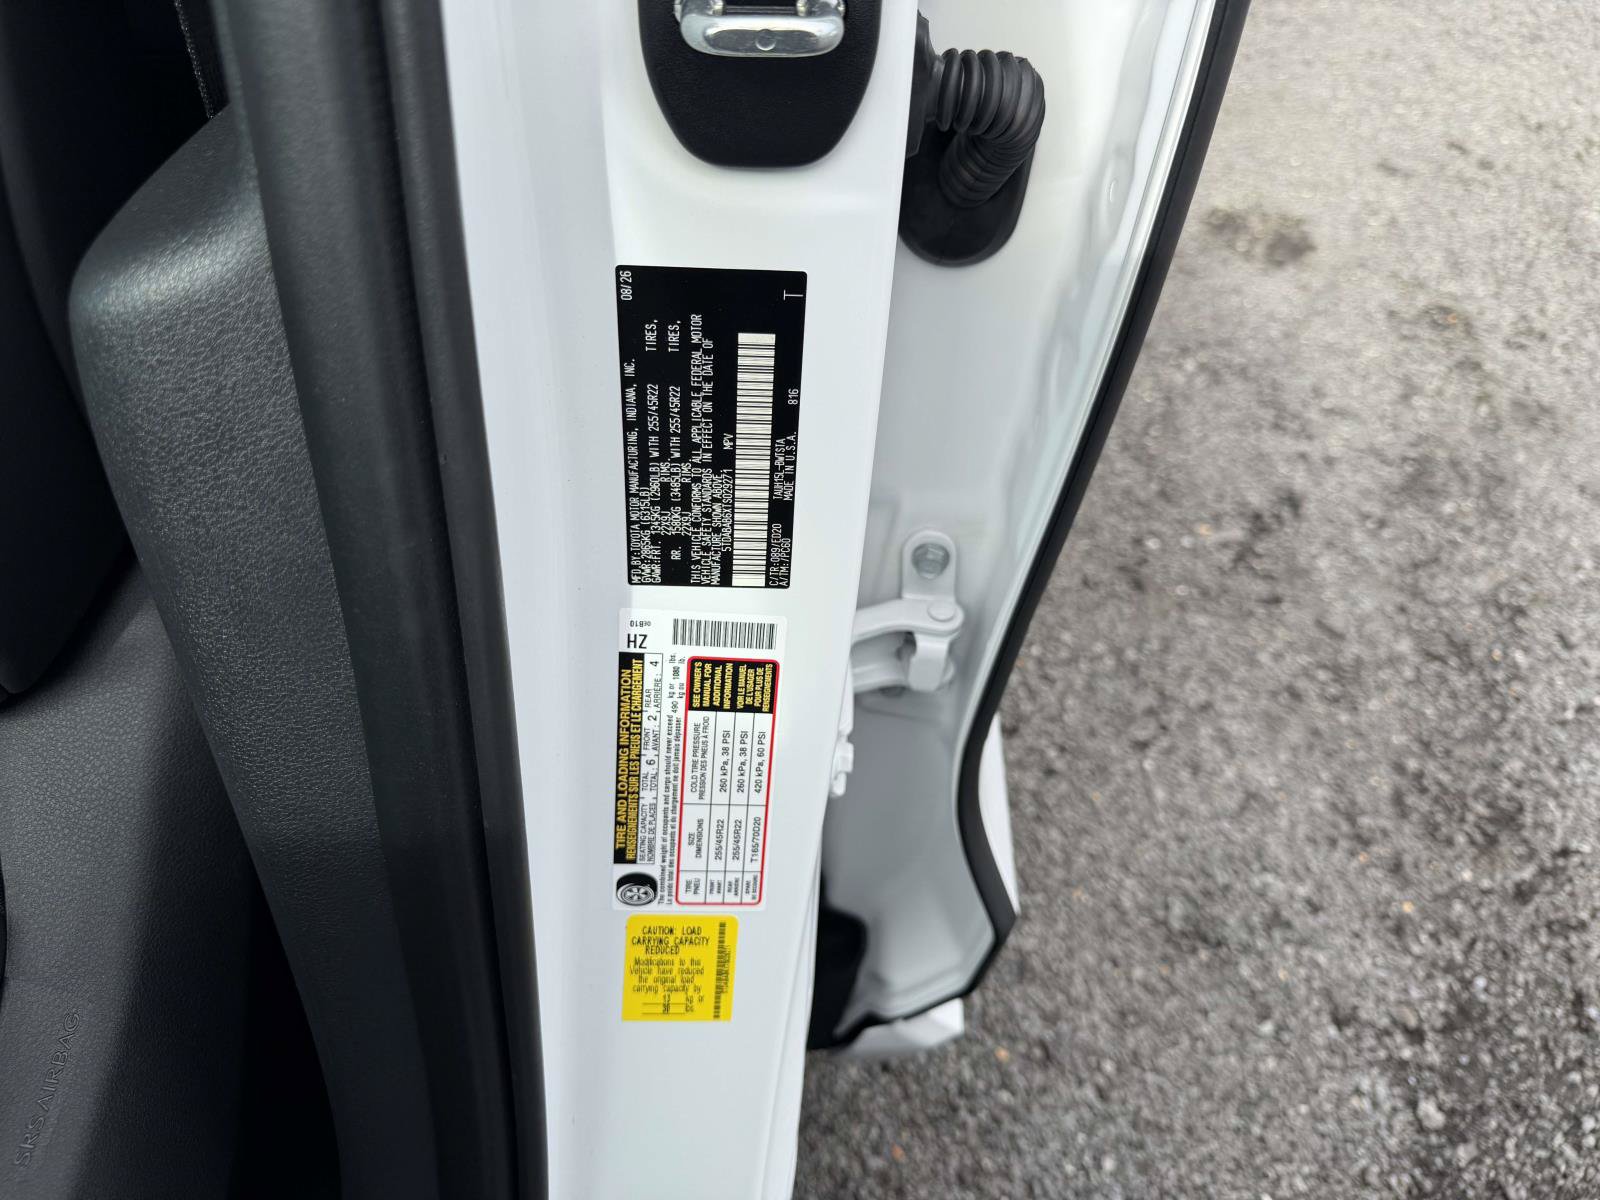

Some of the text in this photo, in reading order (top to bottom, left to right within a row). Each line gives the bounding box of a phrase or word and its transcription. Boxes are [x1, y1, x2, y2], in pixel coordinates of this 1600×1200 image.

[620, 271, 632, 300] 08/26
[784, 290, 803, 300] T
[645, 320, 658, 351] TIRES,
[624, 359, 635, 376] INC.
[625, 384, 637, 421] INDIANA,
[647, 384, 659, 431] 255/45R22
[788, 389, 798, 404] 816
[649, 436, 659, 457] WITH
[669, 320, 681, 559] RR. 1580KG (3485LB) WITH 255/45R22 TIRES,
[691, 314, 702, 583] THIS VEHICLE CONFORMS TO ALL APPLICABLE FEDERAL MOTOR
[724, 433, 733, 449] MPV
[627, 428, 639, 493] MANUFACTURING,
[701, 338, 713, 584] VEHICLE SAFETY STANDARDS IN EFFECT ON THE DATE OF
[784, 432, 796, 500] MADE IN U.S.A.
[650, 463, 660, 501] (2960LB)
[661, 458, 671, 535] 22X9J RIMS.
[682, 459, 691, 536] 22X9J RIMS.
[630, 498, 639, 520] MOTOR
[640, 487, 650, 524] (6315LB)
[651, 506, 660, 534] 1345KG
[711, 470, 722, 585] MANUFACTURE SHOWN ABOVE.
[692, 662, 702, 708] SEE OWNER'S
[703, 664, 712, 707] MANUAL FOR
[714, 665, 722, 706] ADDITIONAL
[723, 663, 733, 709] INFORMATION
[754, 691, 762, 706] POUR
[763, 664, 773, 712] RENSEIGNEMENTS
[722, 730, 731, 743] PSI
[722, 747, 729, 756] 38
[739, 748, 747, 756] 38
[740, 731, 748, 744] PSI
[757, 748, 764, 757] 60
[758, 732, 766, 745] PSI
[616, 669, 631, 848] TIRE AND LOADING INFORMATION
[627, 659, 642, 859] RENSEIGNEMENTS SUR LES PNEUS ET LE CHARGEMENT
[720, 759, 730, 776] kPa,
[738, 759, 747, 776] kPa,
[756, 760, 765, 776] kPa,
[715, 819, 724, 860] 255/45R22
[732, 819, 742, 860] 255/45R22
[751, 817, 761, 862] T165/70D20
[632, 937, 710, 945] CARRYING CAPACITY
[683, 927, 702, 935] LOAD
[645, 946, 680, 955] REDUCED
[15, 1012, 79, 1168] SRS AIRBAG
